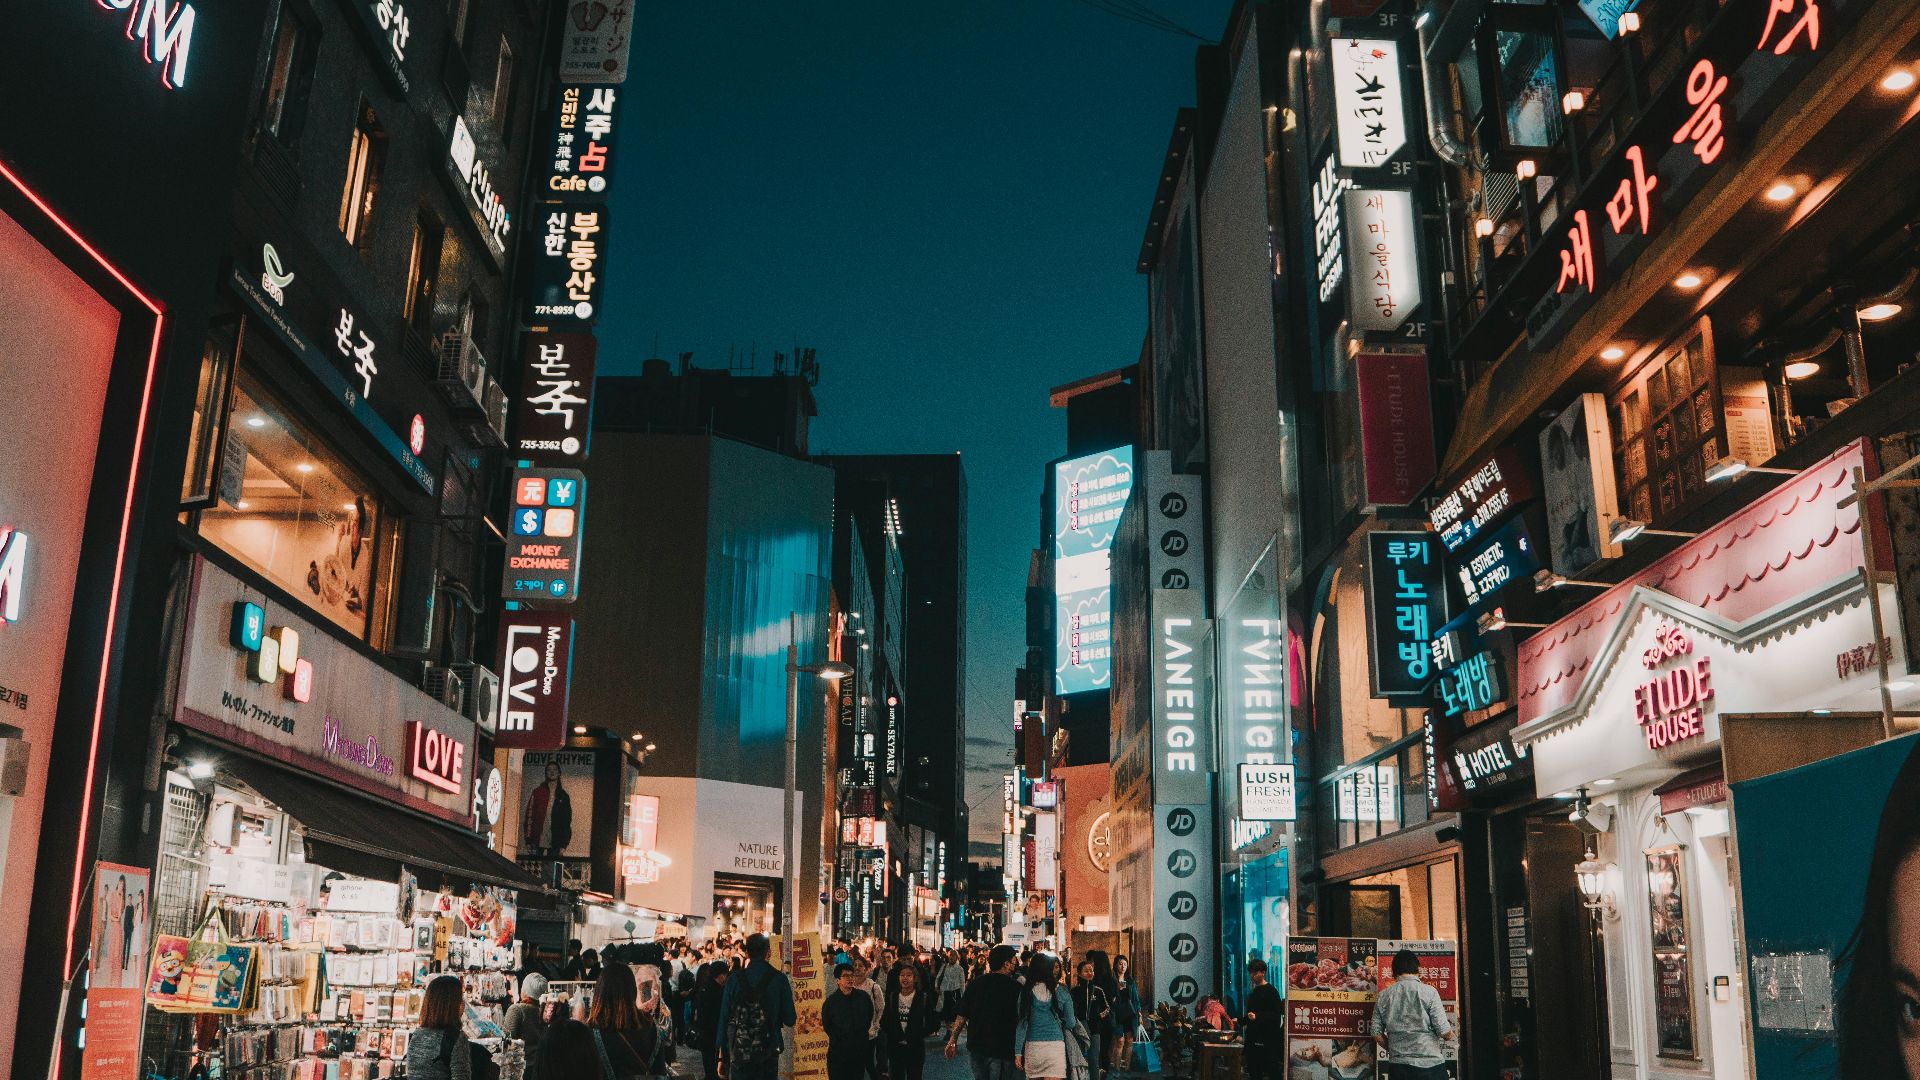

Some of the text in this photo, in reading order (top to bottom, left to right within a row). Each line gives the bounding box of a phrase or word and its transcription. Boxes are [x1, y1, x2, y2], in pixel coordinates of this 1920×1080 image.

[1379, 13, 1398, 26] 3F
[560, 87, 580, 129] 신비안
[1391, 161, 1412, 176] 3F
[549, 175, 587, 193] Cafe
[545, 212, 567, 256] 신한
[566, 212, 600, 301] 부동산
[1365, 194, 1397, 318] 새마을식당
[1406, 323, 1427, 337] 2F
[335, 308, 378, 399] 본죽
[526, 343, 588, 431] 본죽
[1387, 374, 1410, 487] ETUDE HOUSE
[523, 481, 542, 501] 元
[1164, 499, 1184, 513] JD
[522, 509, 538, 534] $
[521, 544, 561, 557] MONEY
[1165, 537, 1185, 551] JD
[1386, 541, 1429, 565] 루키
[510, 557, 570, 570] EXCHANGE
[1470, 541, 1504, 577] ESTHETIC
[513, 579, 564, 592] 오케이 1F
[1165, 574, 1186, 588] JD
[1395, 569, 1432, 679] 노래방
[1431, 631, 1455, 671] 루키
[500, 624, 542, 731] LOVE
[1440, 651, 1492, 718] 노래방
[1164, 618, 1196, 771] LANEIGE
[1634, 655, 1714, 726] ETUDE
[1645, 708, 1704, 750] HOUSE
[413, 720, 464, 795] LOVE
[556, 752, 593, 766] RHYME
[886, 729, 896, 774] SKYPARK
[1467, 741, 1512, 778] HOTEL
[1246, 772, 1290, 784] LUSH
[1246, 786, 1291, 797] FRESH
[1690, 784, 1716, 803] ETUDE
[1170, 814, 1192, 829] JD
[737, 842, 779, 857] NATURE
[734, 856, 783, 871] REPUBLIC
[1171, 856, 1194, 871] JD
[836, 890, 846, 899] 30
[1171, 898, 1194, 913] JD
[1172, 940, 1195, 955] JD
[1173, 982, 1196, 997] JD
[1312, 1006, 1365, 1016] Guest House
[1312, 1017, 1337, 1025] Hotel
